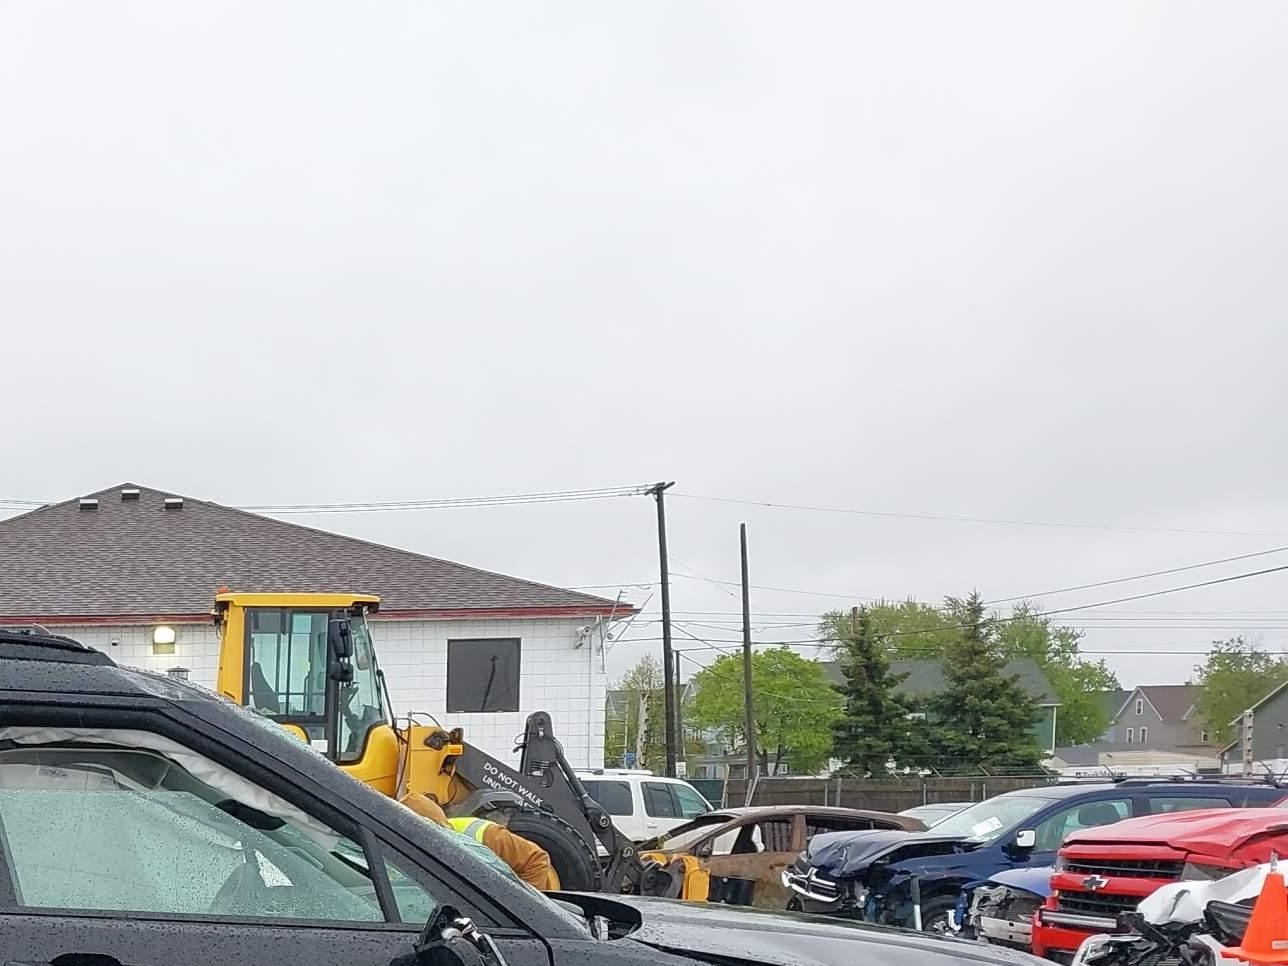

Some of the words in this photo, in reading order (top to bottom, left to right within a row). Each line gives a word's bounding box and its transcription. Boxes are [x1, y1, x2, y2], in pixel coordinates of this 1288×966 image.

[482, 775, 507, 790] UND
[483, 762, 498, 775] DO
[497, 772, 519, 788] NOT
[518, 785, 544, 807] WALK
